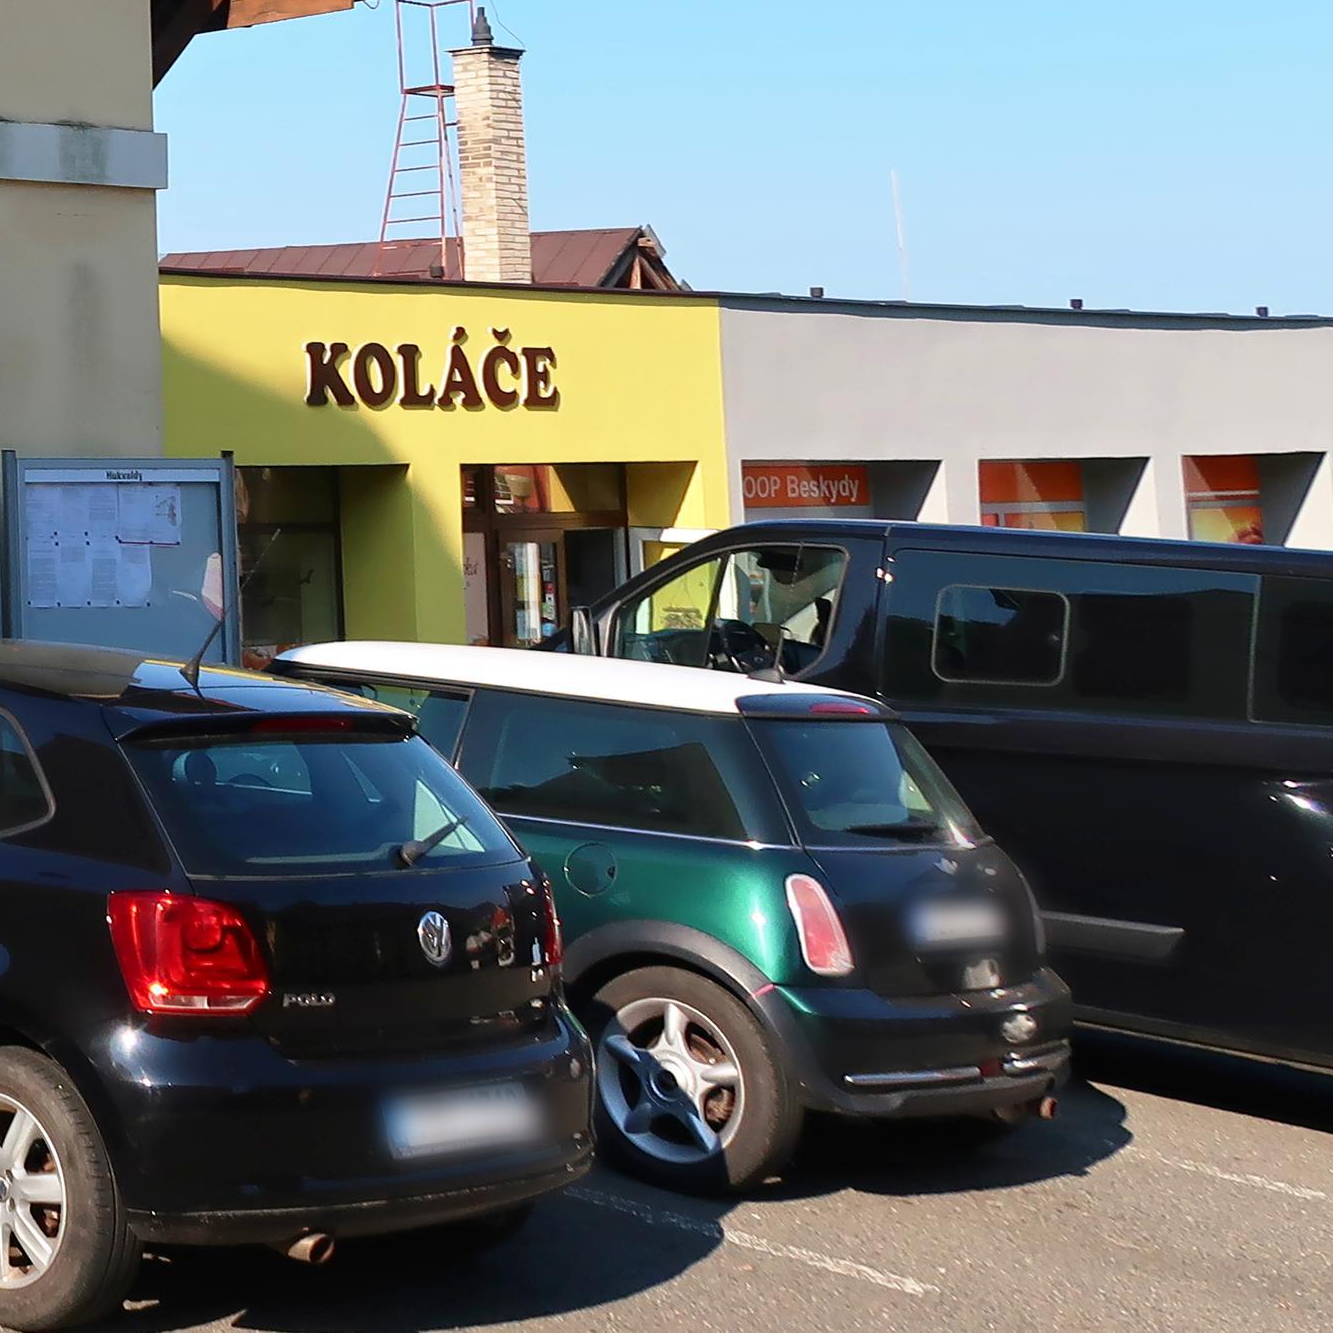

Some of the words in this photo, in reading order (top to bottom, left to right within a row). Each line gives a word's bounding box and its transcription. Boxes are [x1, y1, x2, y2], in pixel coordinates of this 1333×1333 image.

[304, 326, 559, 408] KOLÁČE
[786, 474, 859, 503] Beskydy
[282, 993, 335, 1008] POLO
